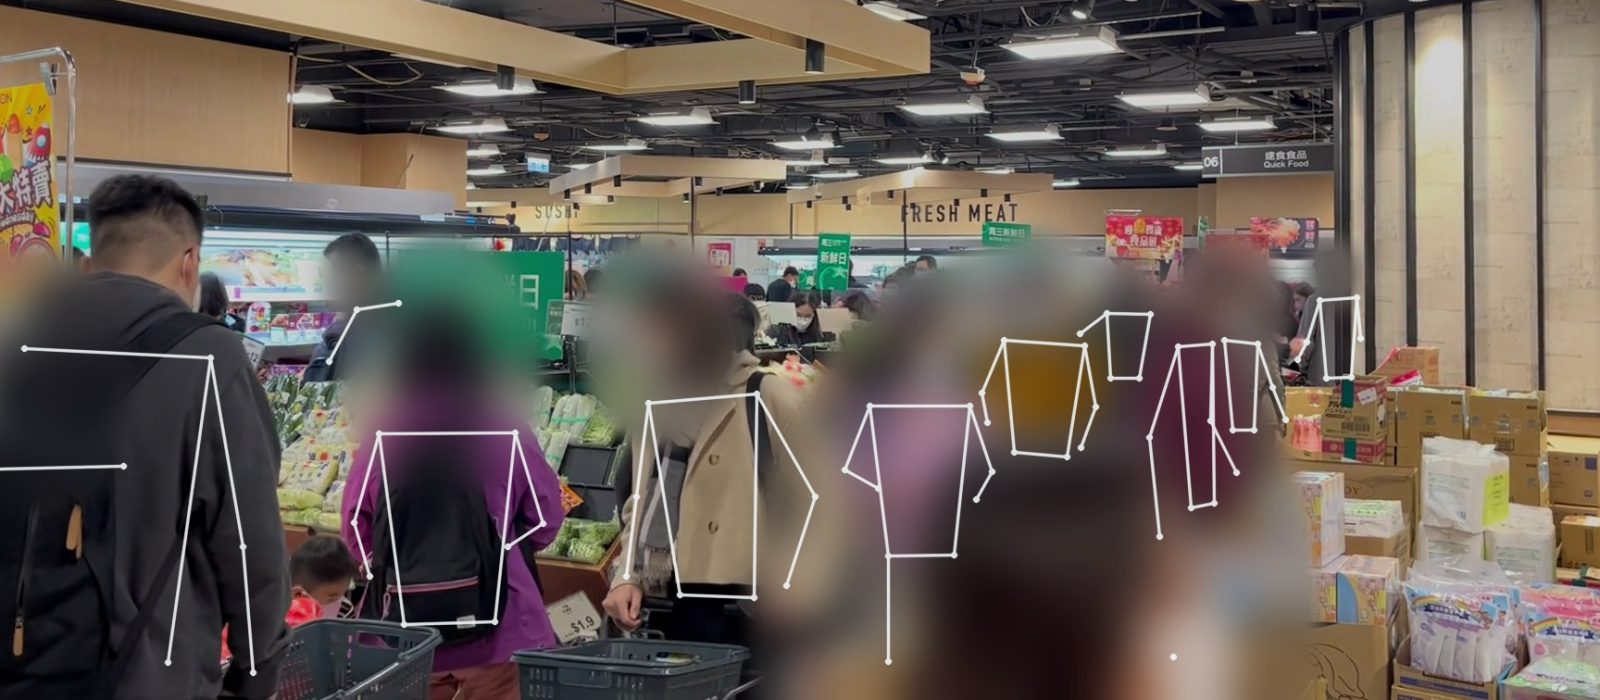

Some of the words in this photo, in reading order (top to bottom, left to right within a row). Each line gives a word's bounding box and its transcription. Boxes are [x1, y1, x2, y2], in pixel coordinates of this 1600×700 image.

[1203, 156, 1219, 168] 06
[1263, 161, 1286, 169] Quick
[1288, 160, 1309, 168] Food
[901, 204, 958, 223] FRESH
[968, 203, 1018, 223] MEAT
[570, 615, 595, 633] $1.9
